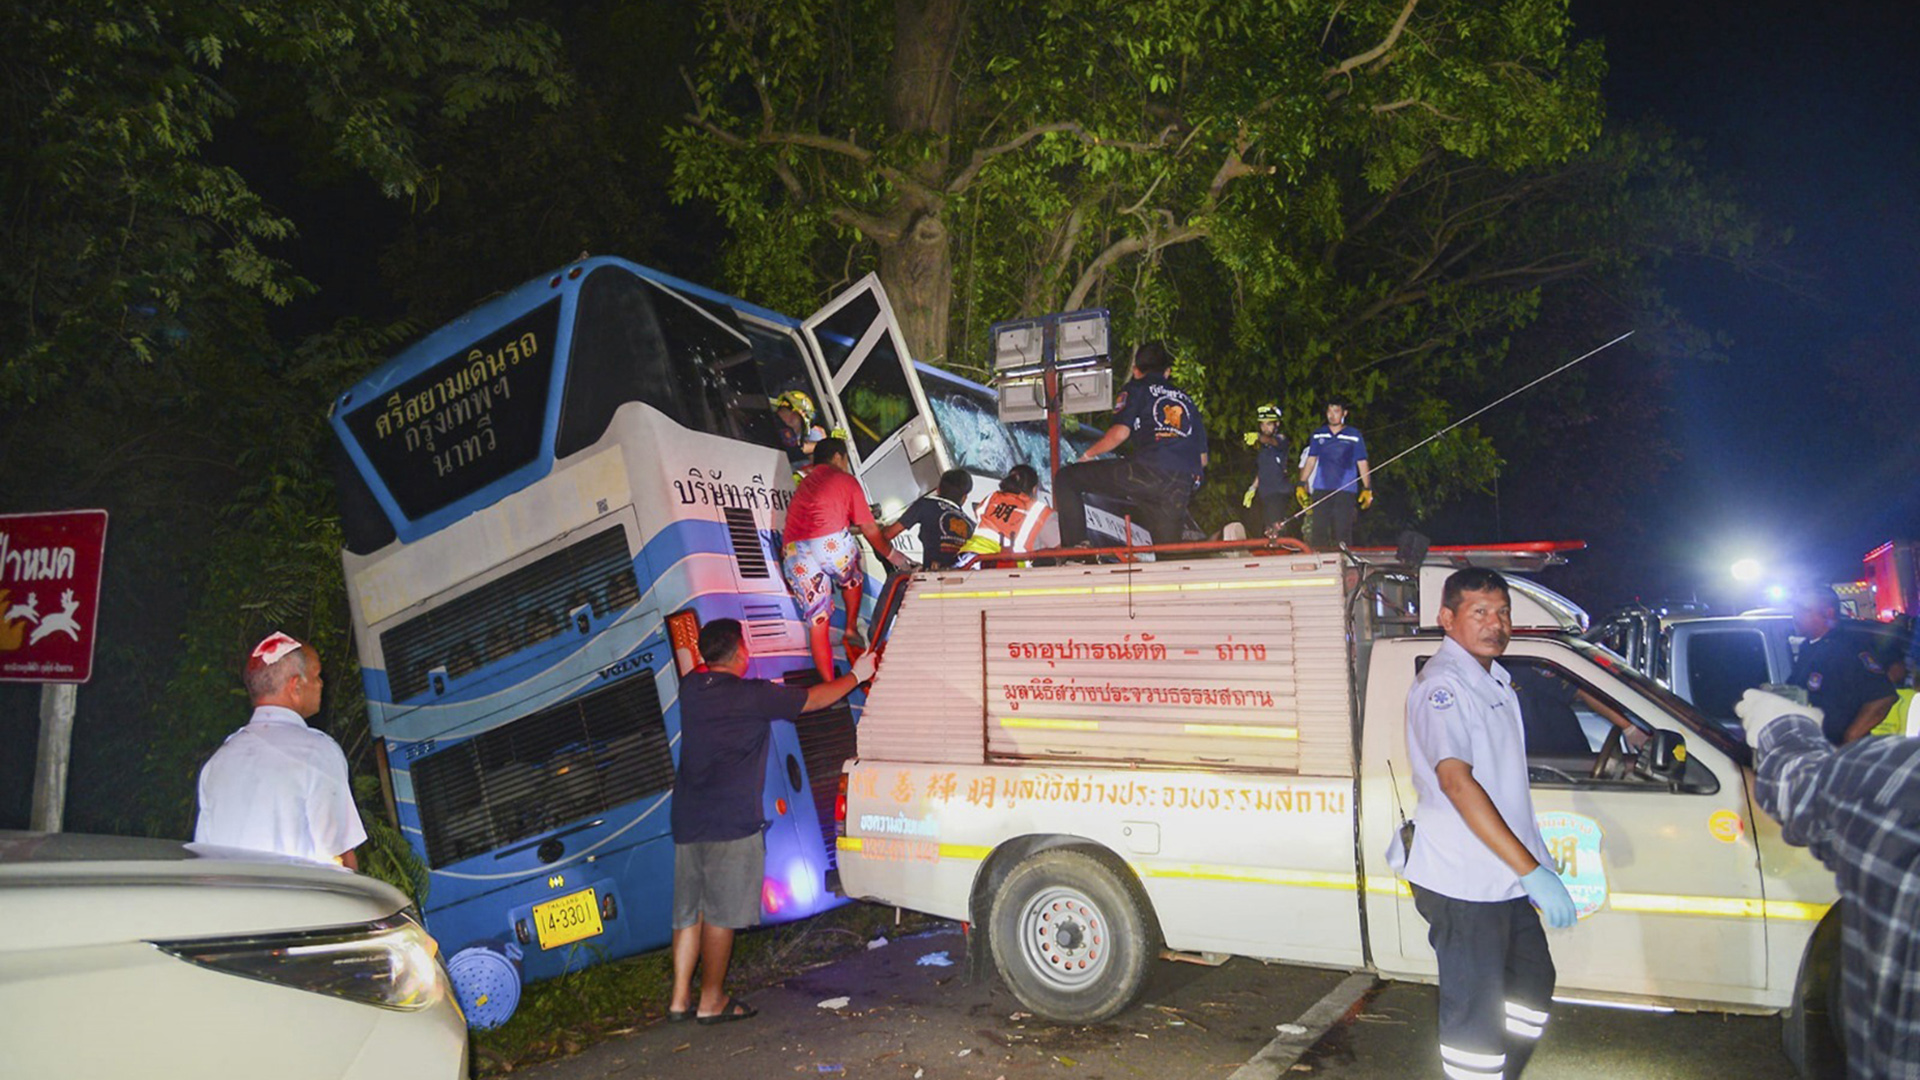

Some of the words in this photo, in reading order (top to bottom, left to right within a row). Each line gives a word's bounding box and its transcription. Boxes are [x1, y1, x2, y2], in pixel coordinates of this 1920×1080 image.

[375, 332, 538, 439] ศรีสยามเดินรถ
[405, 376, 510, 452] กรุงเทพฯ
[433, 413, 496, 477] นาทวี
[597, 652, 654, 680] VOLVO
[1007, 632, 1167, 668] รถอุปกรณ์ตัด
[1215, 634, 1267, 661] ถ่าง
[1003, 677, 1274, 711] มูลนิธิสว่างประจวบธรรมสถาน
